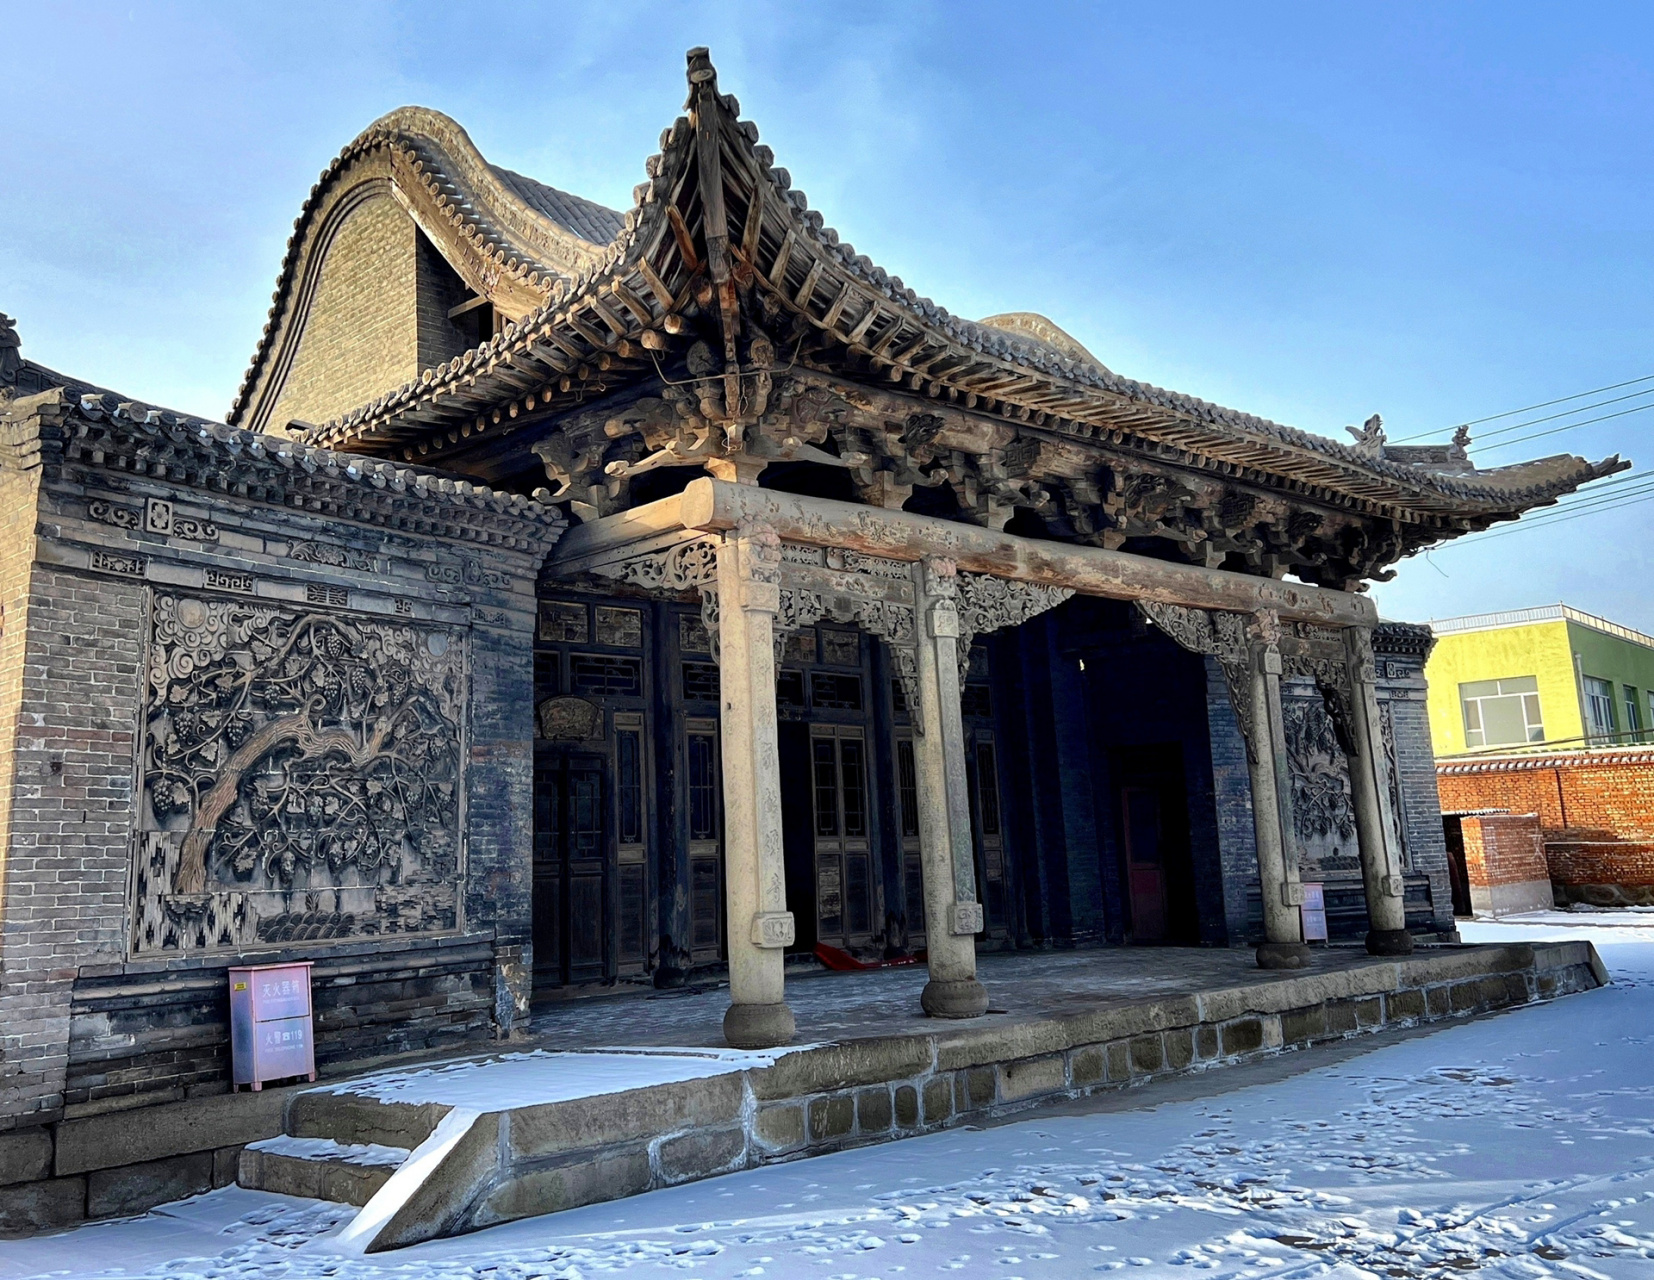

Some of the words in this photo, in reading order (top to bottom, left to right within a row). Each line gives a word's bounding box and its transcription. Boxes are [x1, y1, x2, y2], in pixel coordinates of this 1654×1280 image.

[262, 980, 300, 997] 灭火器箱
[291, 1029, 303, 1040] 119
